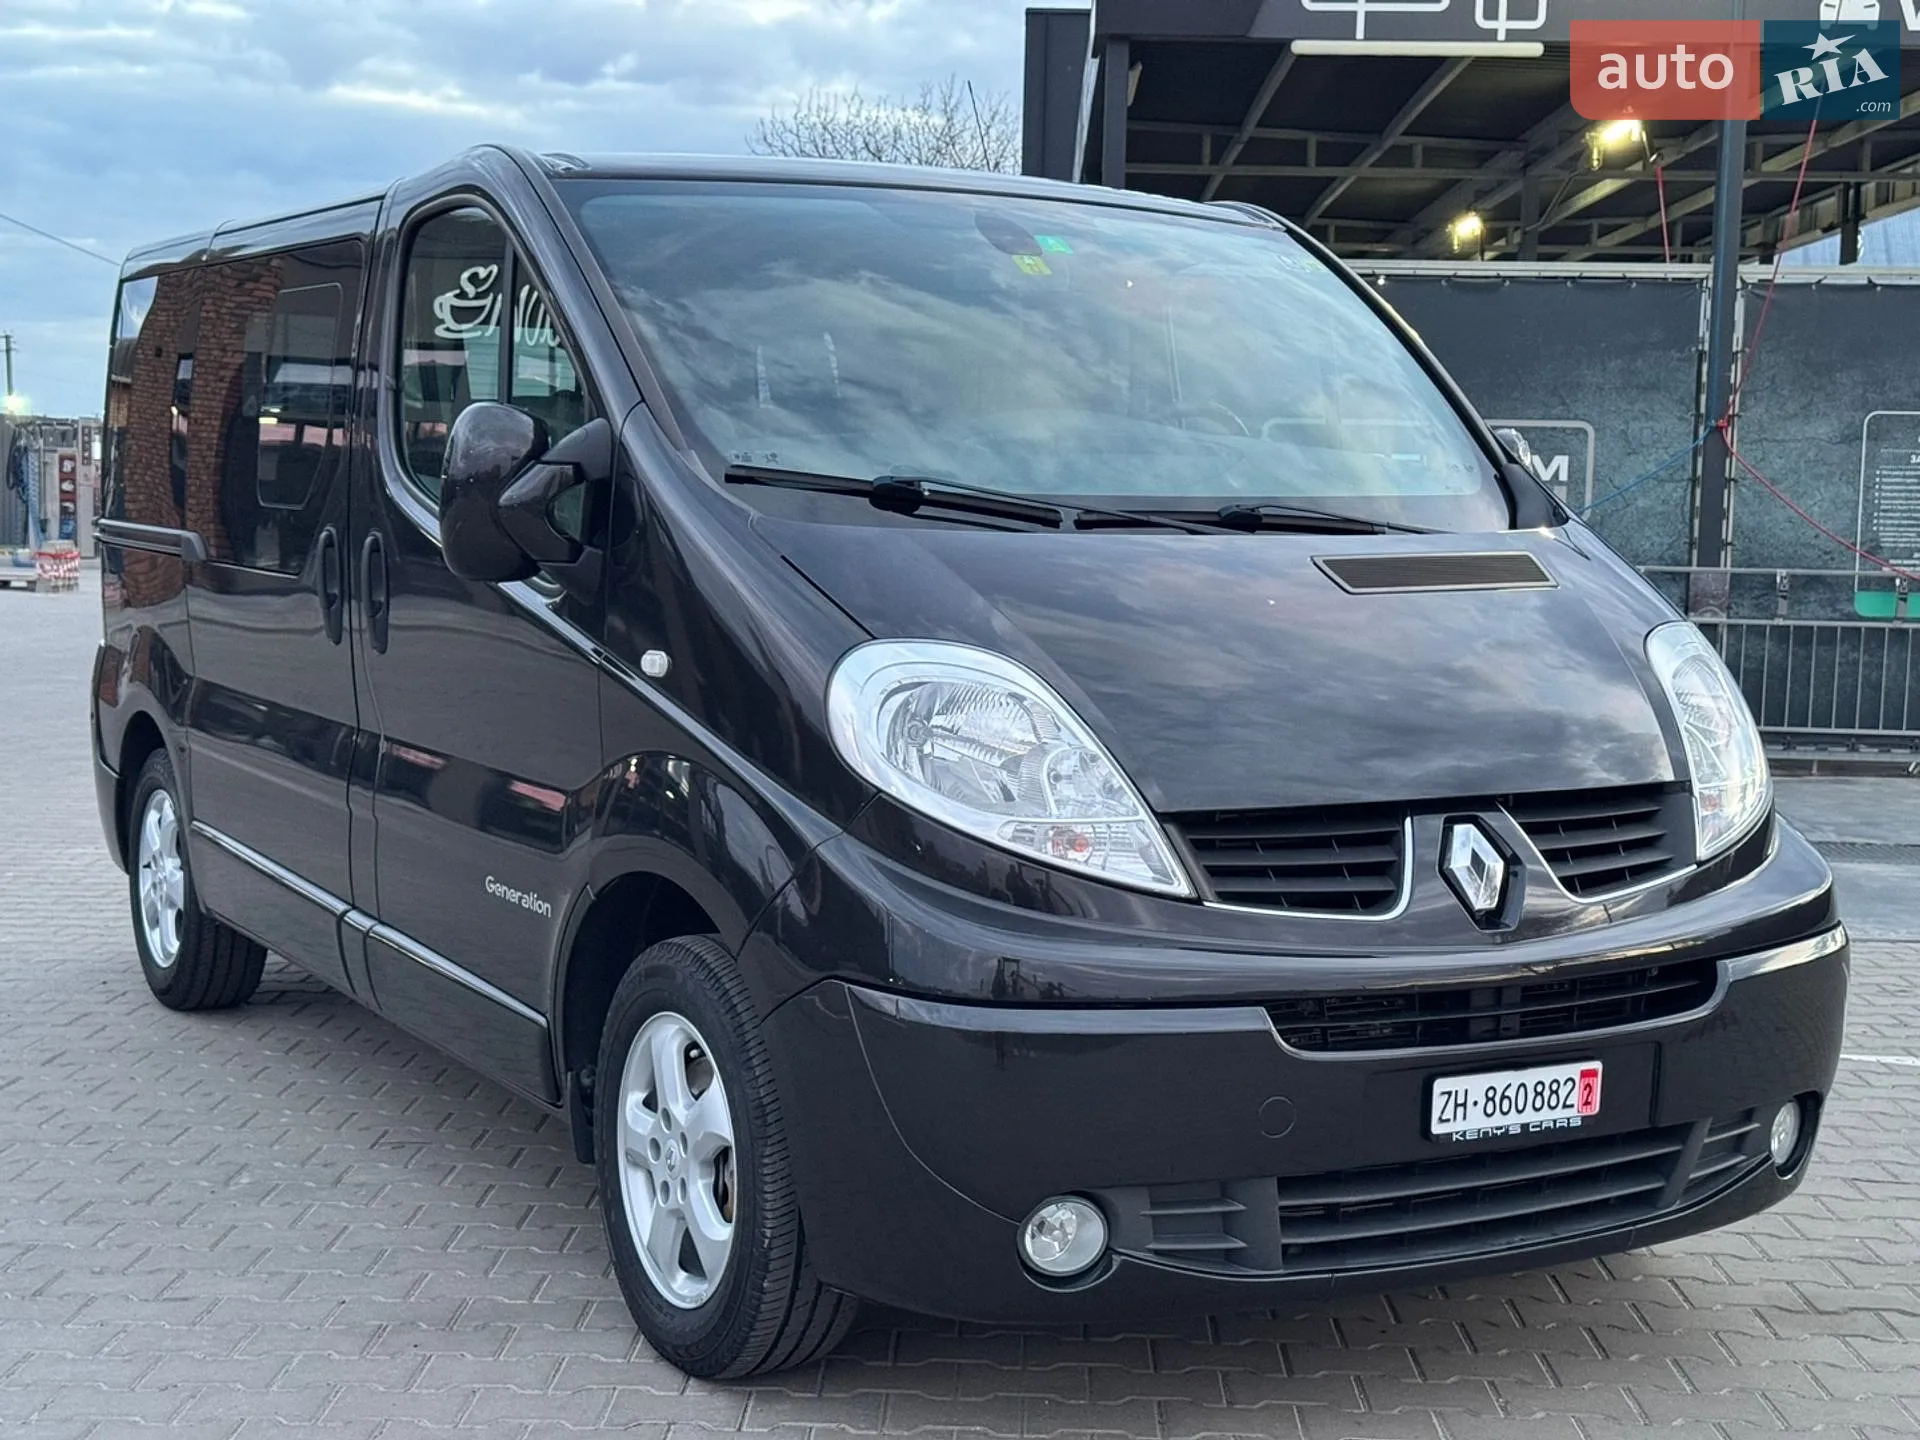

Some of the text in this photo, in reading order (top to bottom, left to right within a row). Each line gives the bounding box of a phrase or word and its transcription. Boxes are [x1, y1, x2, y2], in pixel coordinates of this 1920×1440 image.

[485, 875, 551, 918] Generation
[1452, 1116, 1582, 1142] KENY'S CARS
